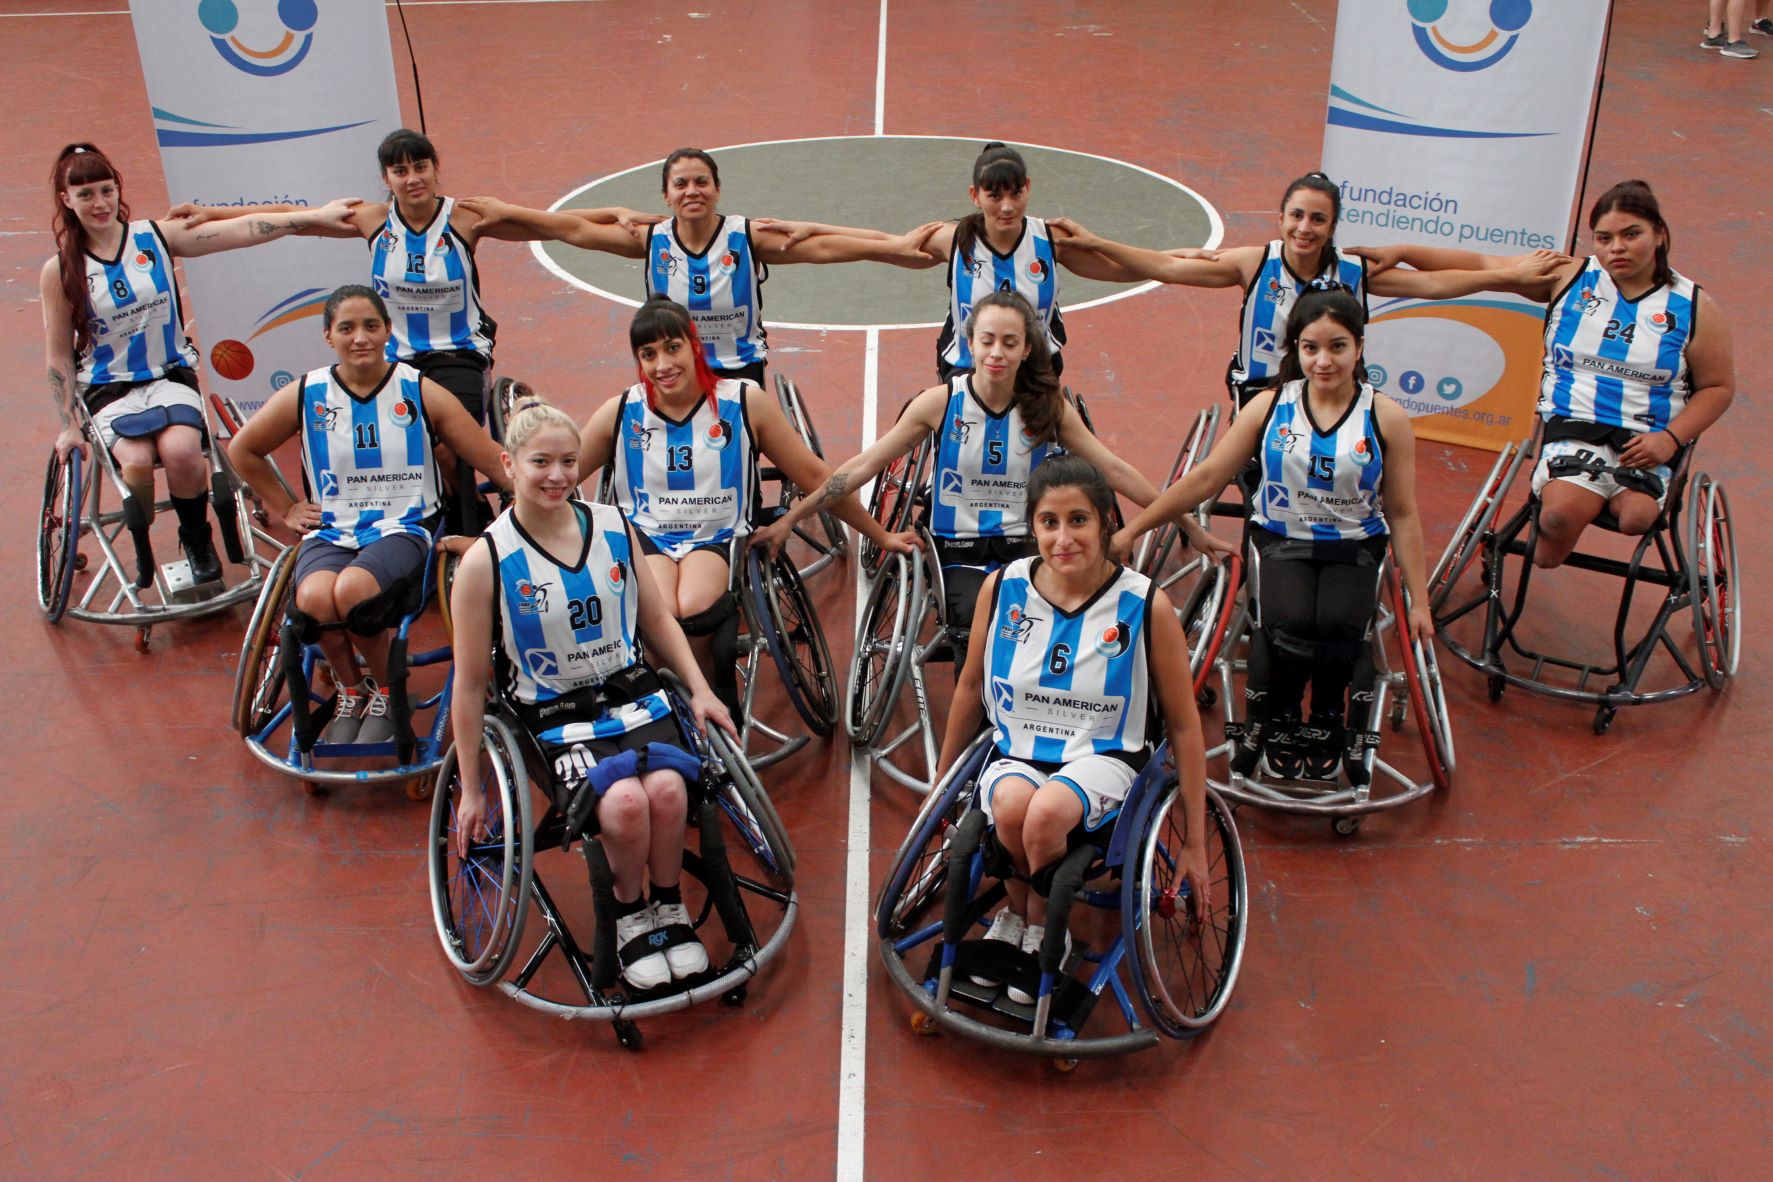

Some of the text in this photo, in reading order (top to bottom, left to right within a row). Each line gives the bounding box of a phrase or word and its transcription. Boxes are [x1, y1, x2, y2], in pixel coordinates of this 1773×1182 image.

[1339, 181, 1458, 214] fundación
[1338, 207, 1555, 249] tendiendo puentes
[407, 253, 425, 274] 12
[113, 279, 128, 298] 8
[395, 285, 461, 295] PAN AMERICAN
[693, 275, 706, 295] 9
[112, 311, 129, 322] PAN
[700, 311, 745, 322] AMERICAN
[1602, 319, 1636, 344] 24
[1582, 358, 1666, 382] PAN AMERICAN
[356, 423, 378, 449] 11
[667, 445, 693, 472] 13
[988, 441, 1003, 465] 5
[1309, 455, 1335, 481] 15
[346, 473, 422, 484] PAN AMERICAN
[992, 481, 1026, 489] AMERIC
[658, 495, 733, 506] PAN AMERICAN
[567, 595, 603, 631] 20
[567, 651, 590, 663] PAN
[1049, 643, 1072, 675] 6
[914, 677, 928, 717] ELITE
[1025, 692, 1119, 712] PAN AMERICAN
[1047, 708, 1095, 721] SILVER
[1023, 723, 1076, 737] ARGENTINA
